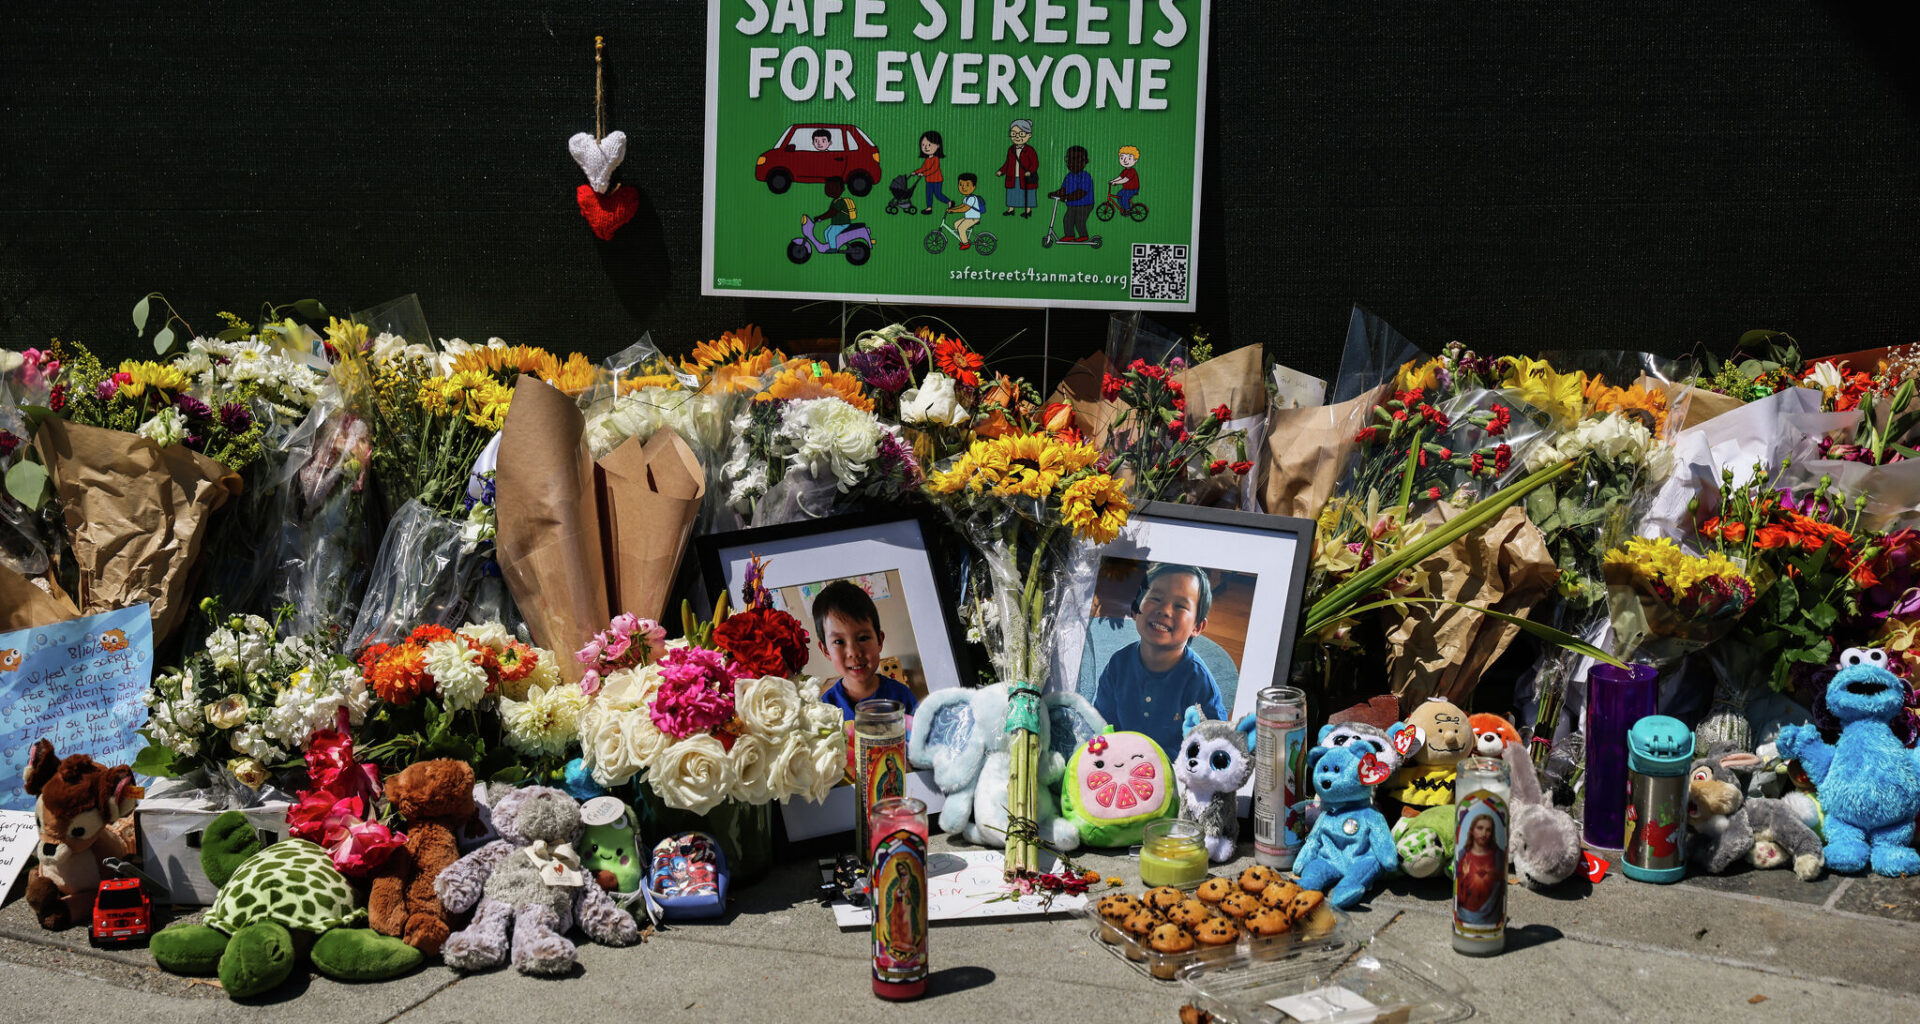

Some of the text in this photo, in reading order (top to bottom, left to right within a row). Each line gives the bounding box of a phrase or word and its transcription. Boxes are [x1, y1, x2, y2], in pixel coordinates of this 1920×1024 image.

[735, 0, 1187, 47] SAFE STREETS
[750, 46, 1171, 110] FOR EVERYONE
[950, 266, 1127, 290] safestreets4sanmateo.org
[48, 682, 72, 694] the
[101, 694, 114, 705] to
[20, 703, 41, 714] the
[86, 708, 108, 723] bad
[1395, 734, 1412, 752] ty
